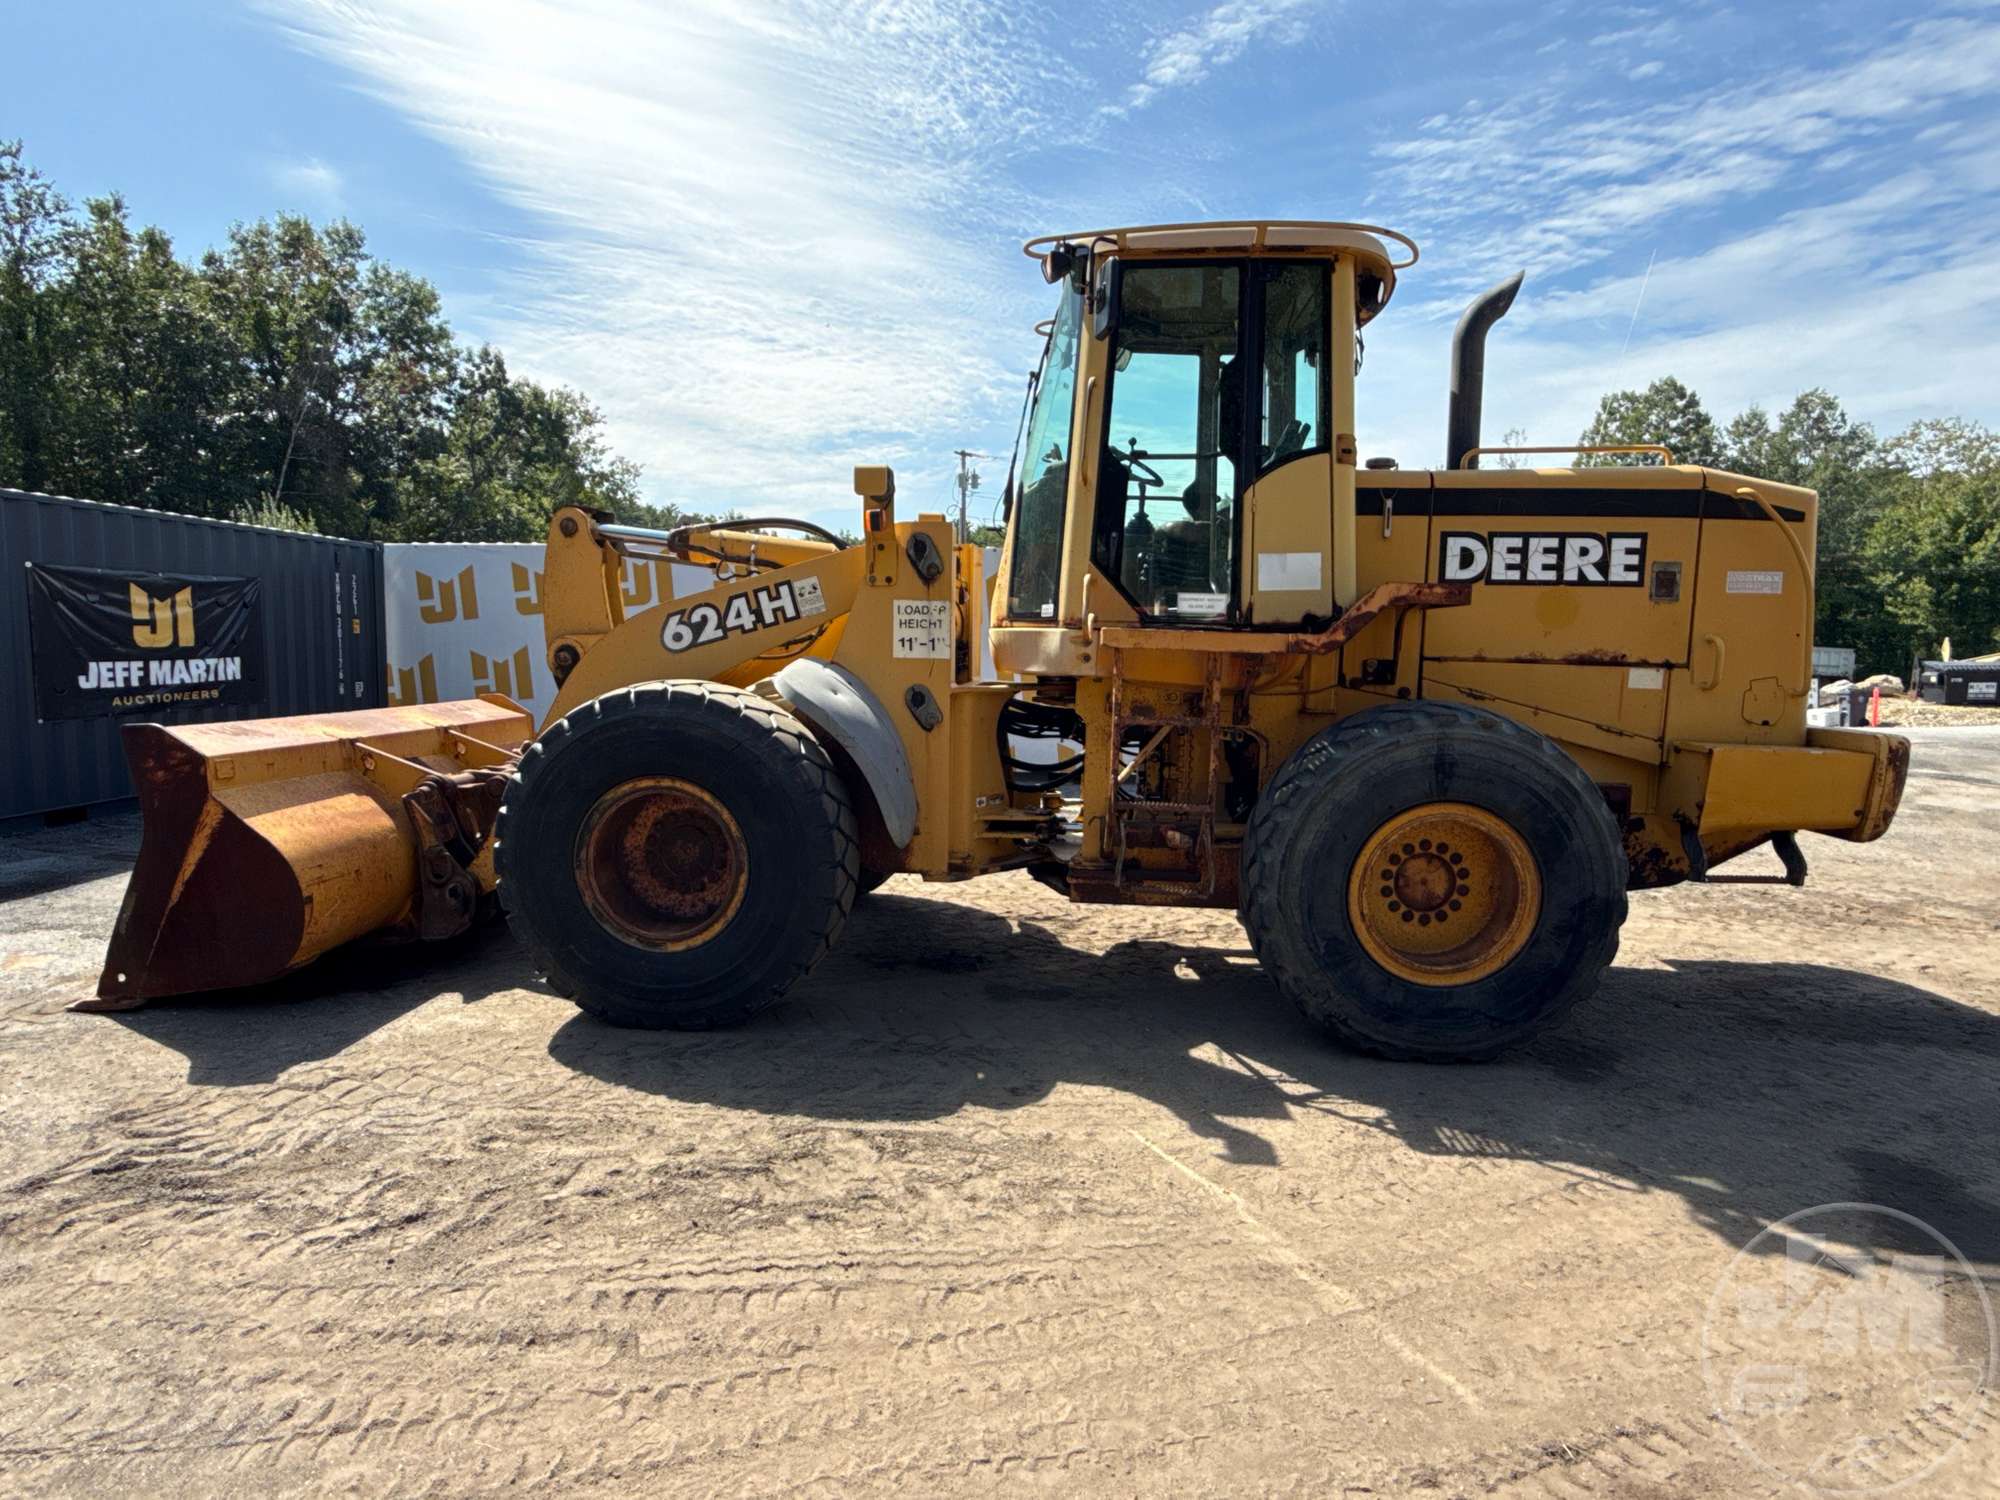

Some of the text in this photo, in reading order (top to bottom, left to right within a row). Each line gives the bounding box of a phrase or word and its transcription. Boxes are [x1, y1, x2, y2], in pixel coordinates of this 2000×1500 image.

[1443, 534, 1645, 584] DEERE
[661, 581, 800, 652] 624H
[897, 604, 947, 615] LOADR
[78, 656, 242, 690] JEFF MARTIN
[112, 688, 220, 707] AUCTIONEERS
